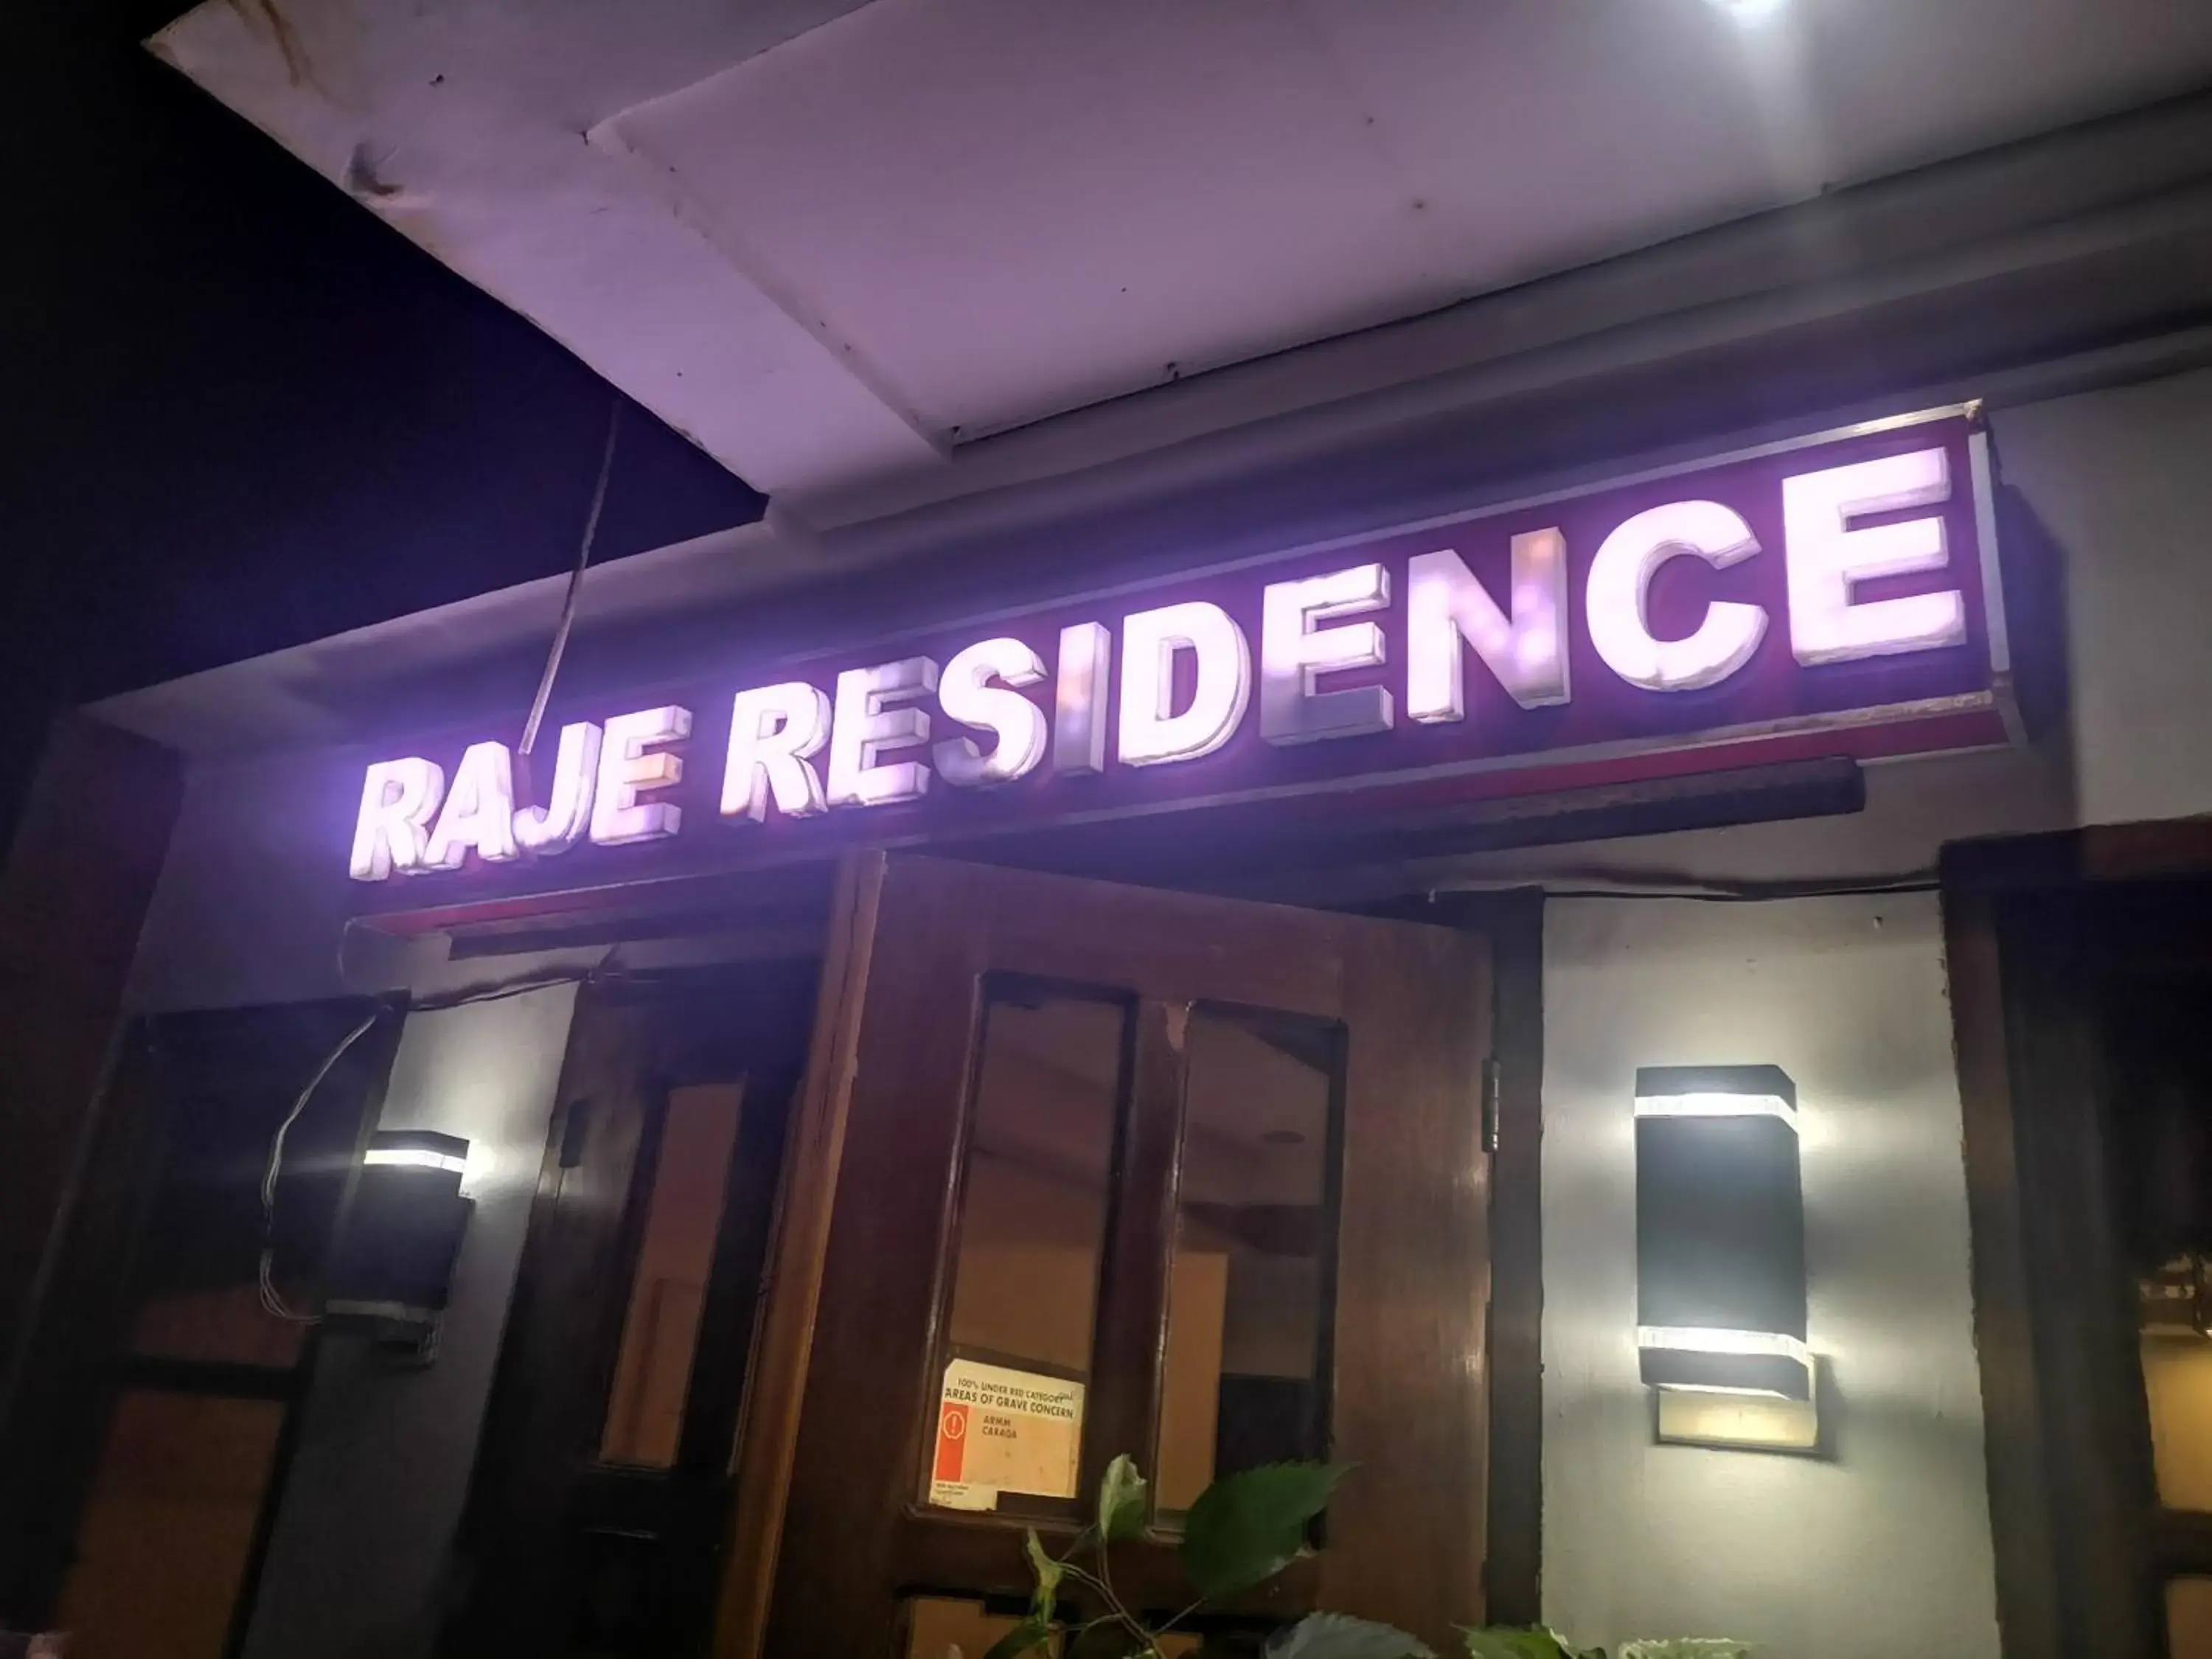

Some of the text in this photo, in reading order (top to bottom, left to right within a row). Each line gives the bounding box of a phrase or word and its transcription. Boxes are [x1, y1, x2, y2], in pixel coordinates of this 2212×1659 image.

[348, 445, 1968, 882] RAJE RESIDENCE
[945, 1388, 1074, 1419] AREAS OF GRAVE CONCERN
[957, 1377, 978, 1390] 100%
[981, 1382, 1008, 1394] UNDER
[1009, 1388, 1023, 1397] RED
[1026, 1390, 1064, 1403] CATEGORY
[983, 1415, 1011, 1427] ARMM
